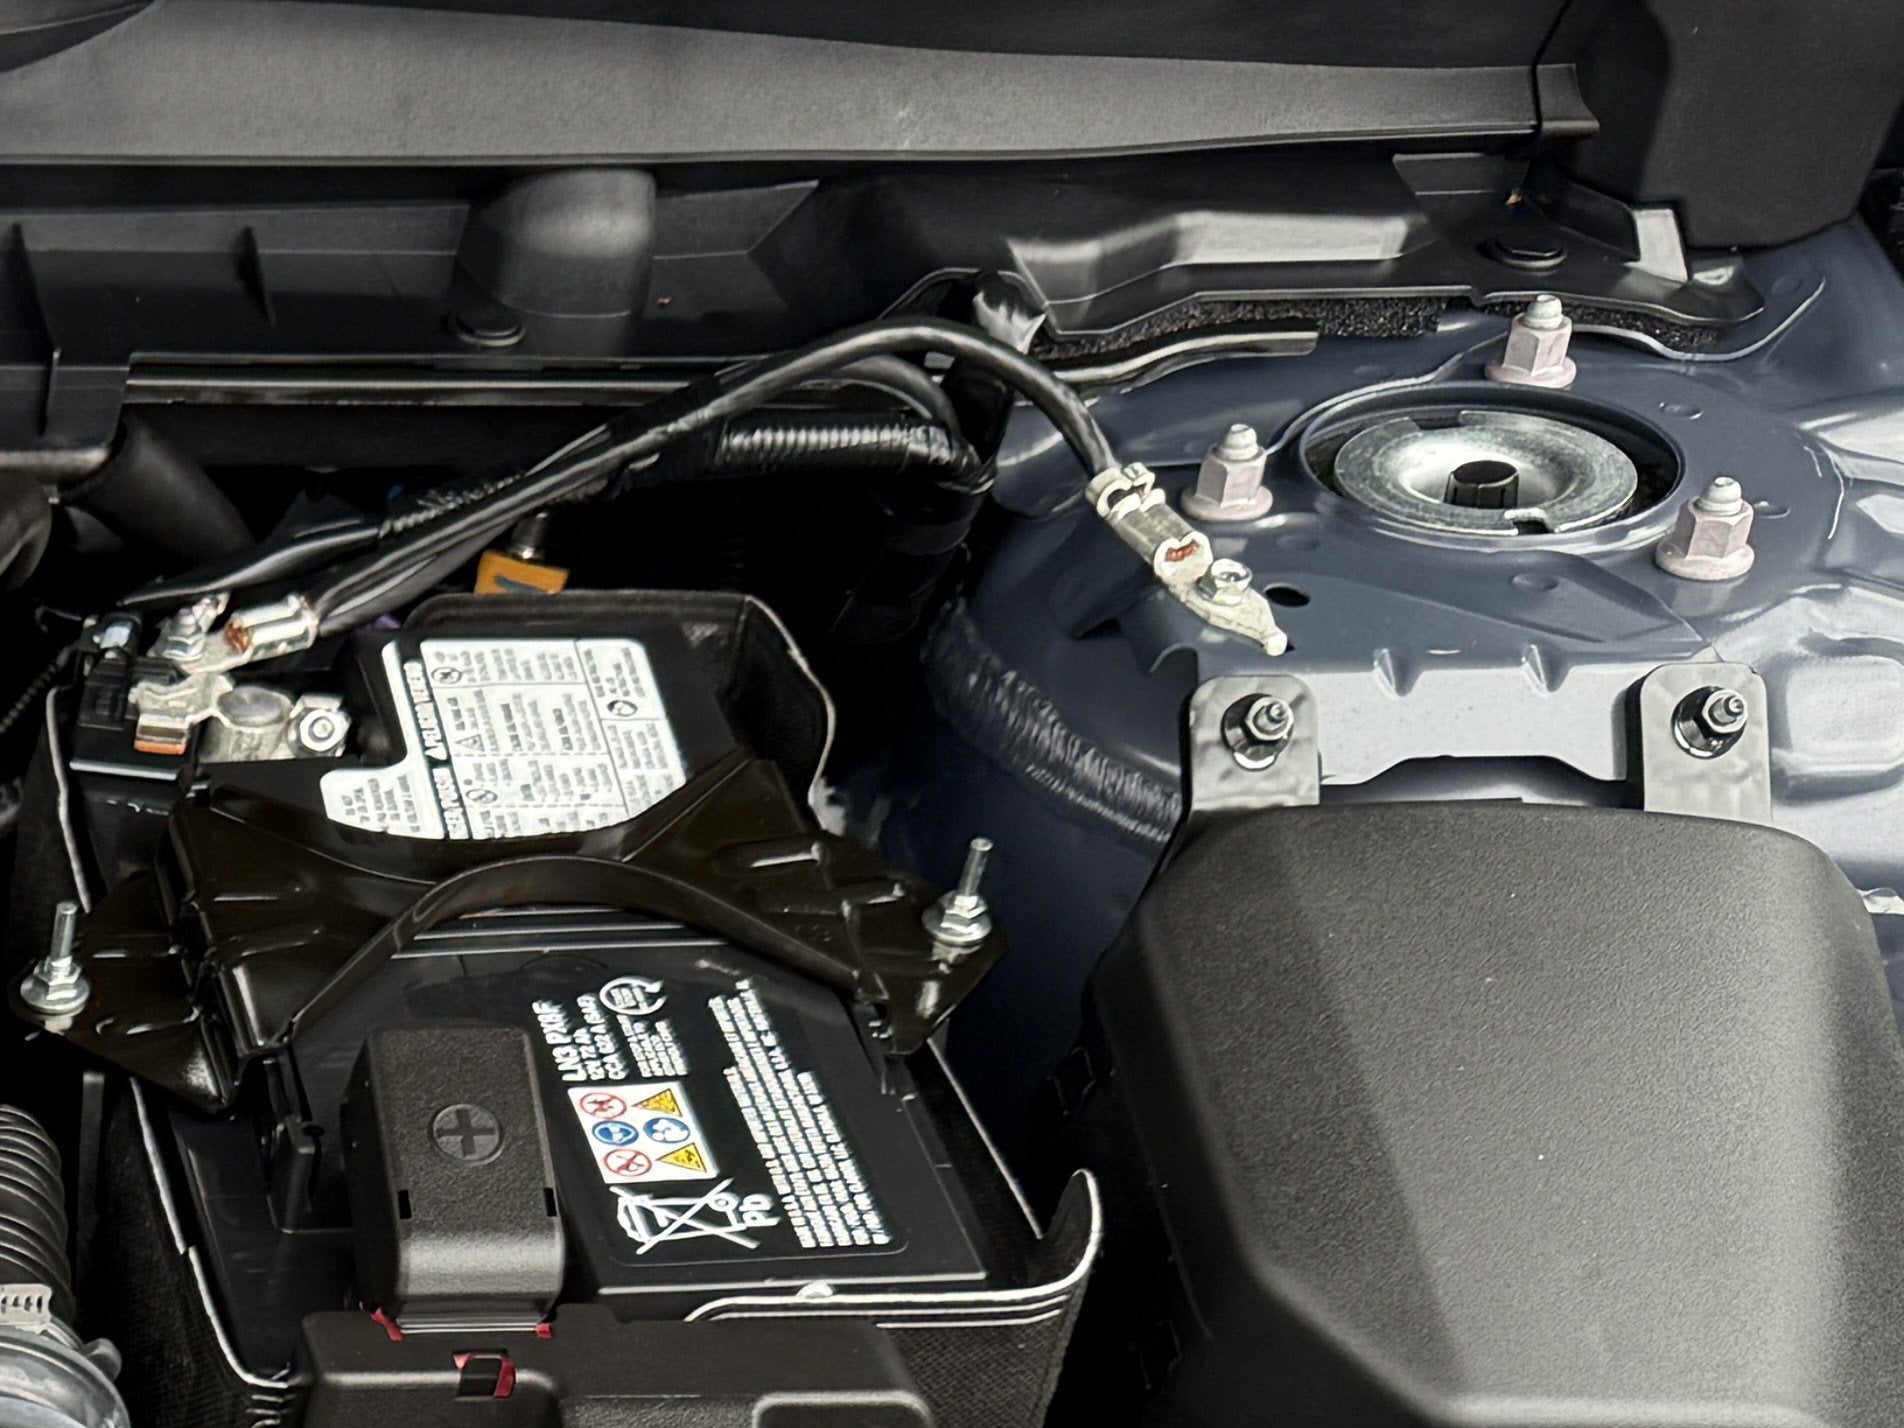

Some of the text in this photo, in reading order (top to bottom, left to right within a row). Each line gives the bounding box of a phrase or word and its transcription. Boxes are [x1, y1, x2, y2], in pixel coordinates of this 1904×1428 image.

[532, 1000, 587, 1081] LN3 PX8F
[739, 1193, 781, 1227] Pb
